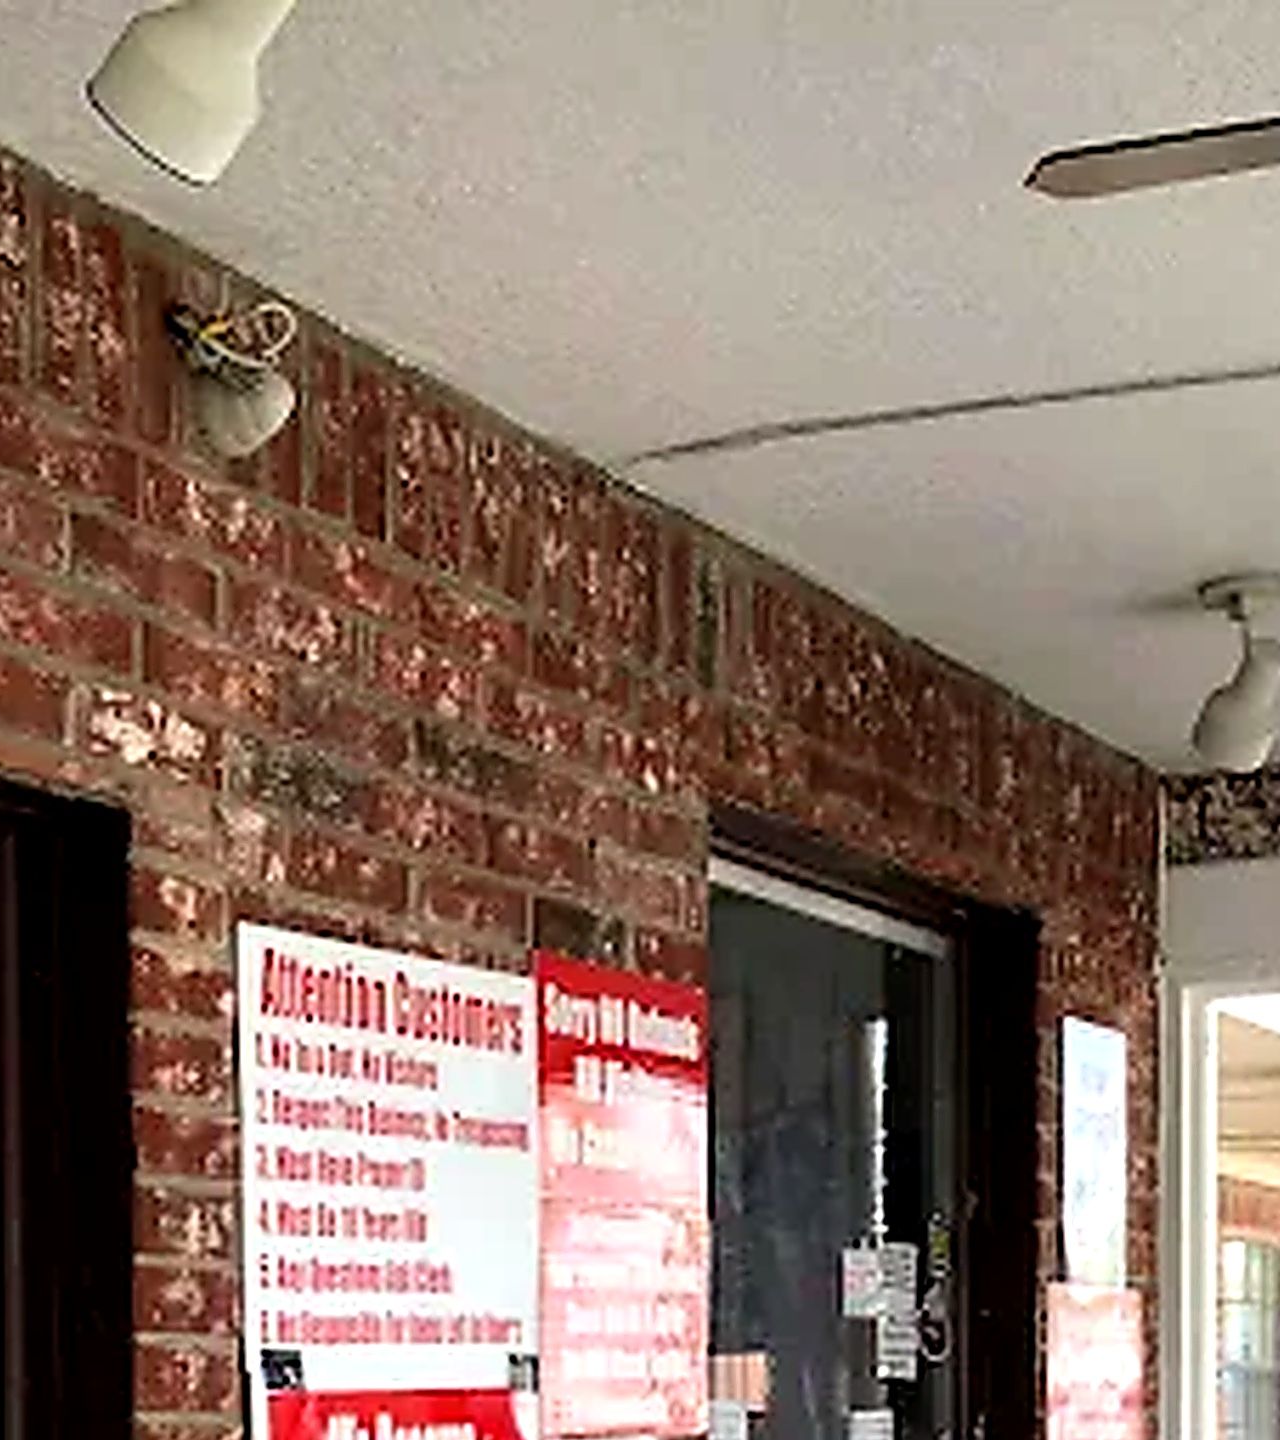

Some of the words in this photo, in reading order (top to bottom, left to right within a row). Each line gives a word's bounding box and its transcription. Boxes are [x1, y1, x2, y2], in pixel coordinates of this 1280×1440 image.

[258, 945, 387, 1035] Attention
[393, 968, 523, 1054] Customers
[544, 981, 597, 1044] Sorry
[270, 1034, 291, 1073] No
[361, 1046, 378, 1084] No
[385, 1049, 438, 1091] Visitors
[275, 1145, 313, 1182] Must
[317, 1149, 353, 1185] Have
[276, 1201, 312, 1236] Must
[316, 1203, 336, 1238] Be
